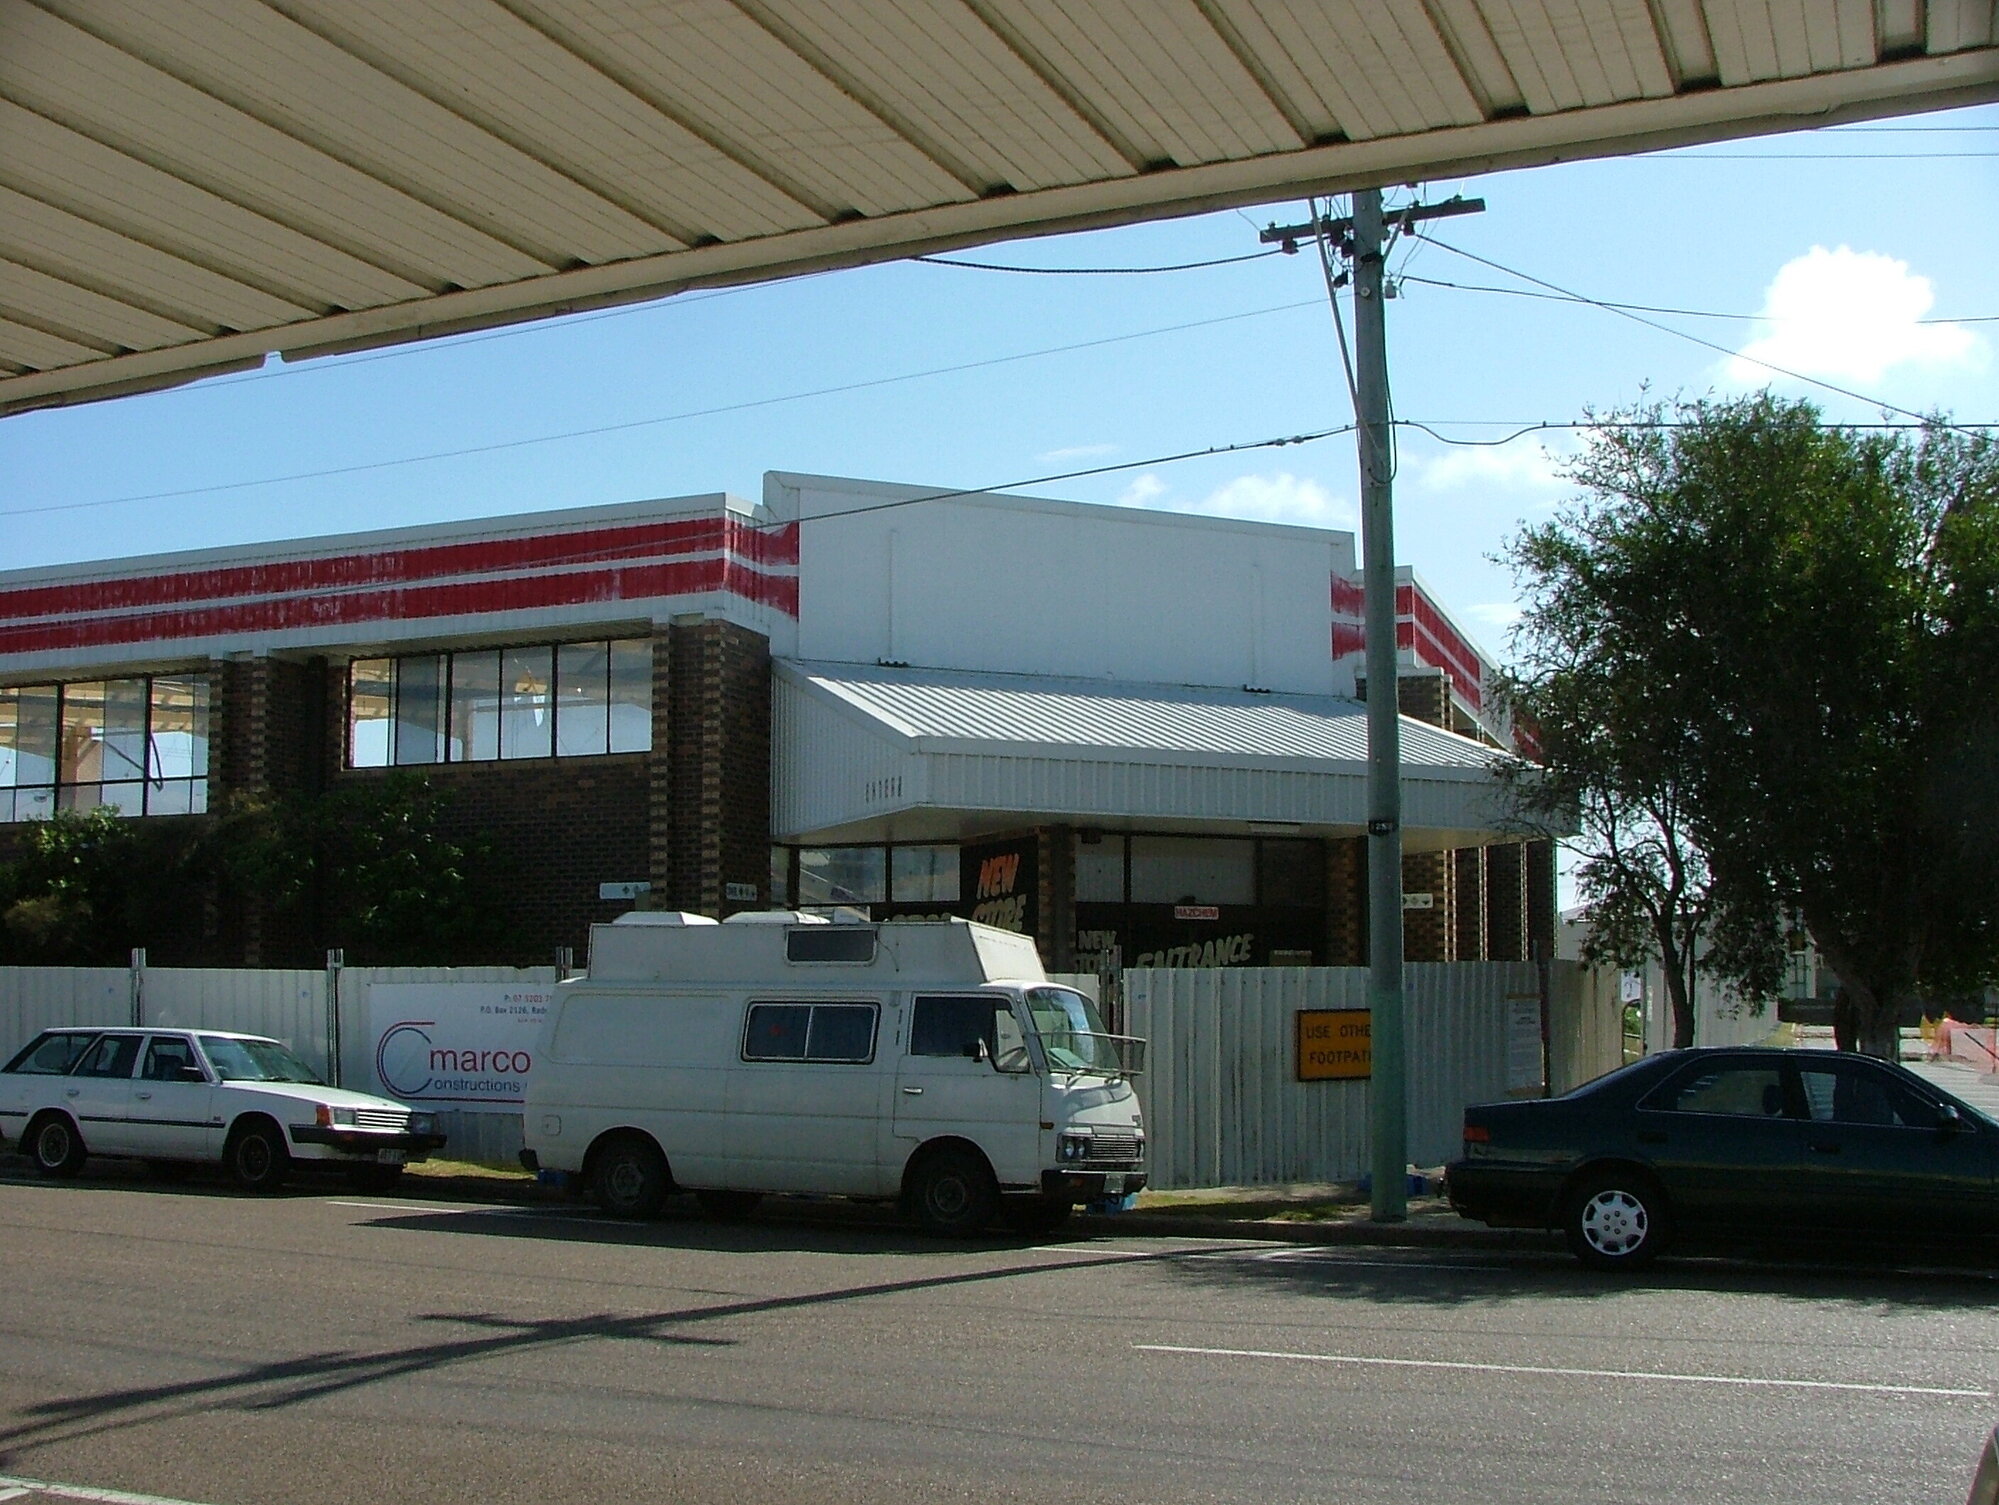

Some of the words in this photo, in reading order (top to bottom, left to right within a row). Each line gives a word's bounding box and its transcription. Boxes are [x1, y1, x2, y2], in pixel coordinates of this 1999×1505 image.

[976, 853, 1019, 900] NEW
[1175, 907, 1218, 918] HAZCHEM
[1078, 930, 1118, 950] NEW
[1306, 1025, 1330, 1039] USE
